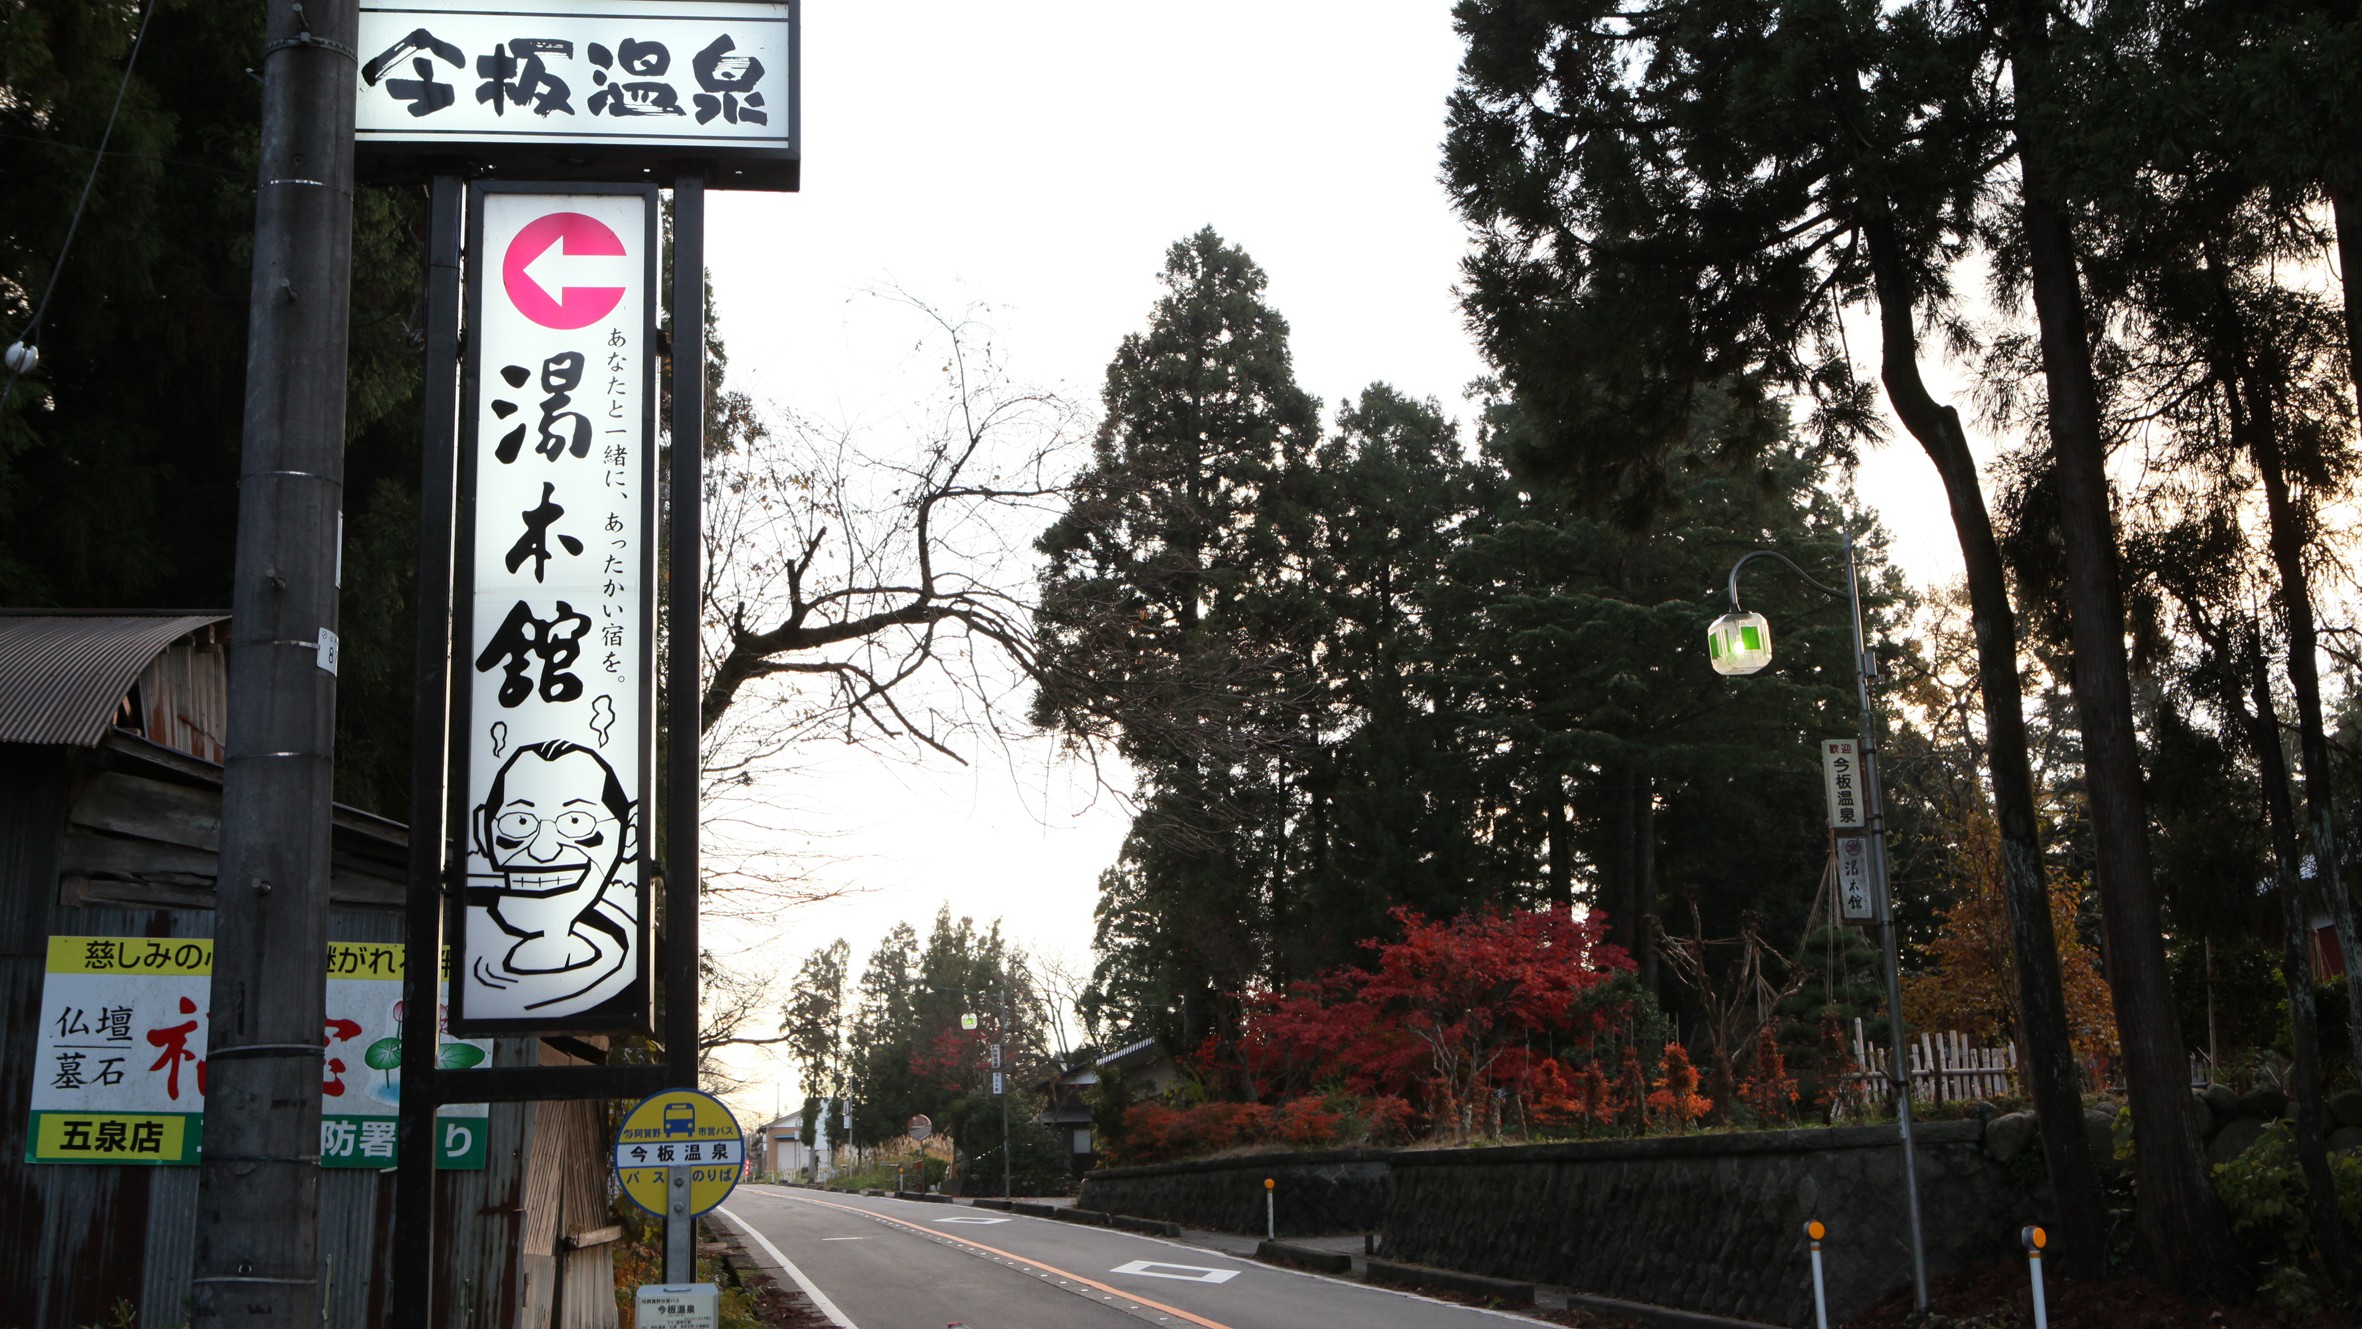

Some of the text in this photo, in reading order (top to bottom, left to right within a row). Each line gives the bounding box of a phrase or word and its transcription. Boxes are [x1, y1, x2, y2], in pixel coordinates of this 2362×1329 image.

[361, 28, 767, 126] 今板温泉
[475, 350, 593, 709] 湯本館
[1829, 743, 1852, 755] 歓迎
[1833, 756, 1857, 823] 今板温泉
[1844, 859, 1863, 910] 湯本館
[84, 940, 212, 970] 慈しみの
[55, 1005, 134, 1042] 仏壇
[50, 1052, 126, 1090] 墓石
[59, 1119, 165, 1154] 五泉店
[698, 1126, 734, 1137] 市営バス
[630, 1143, 729, 1163] 今板温泉
[626, 1170, 665, 1184] バス
[692, 1167, 732, 1182] のりば
[658, 1304, 695, 1315] 今板温泉
